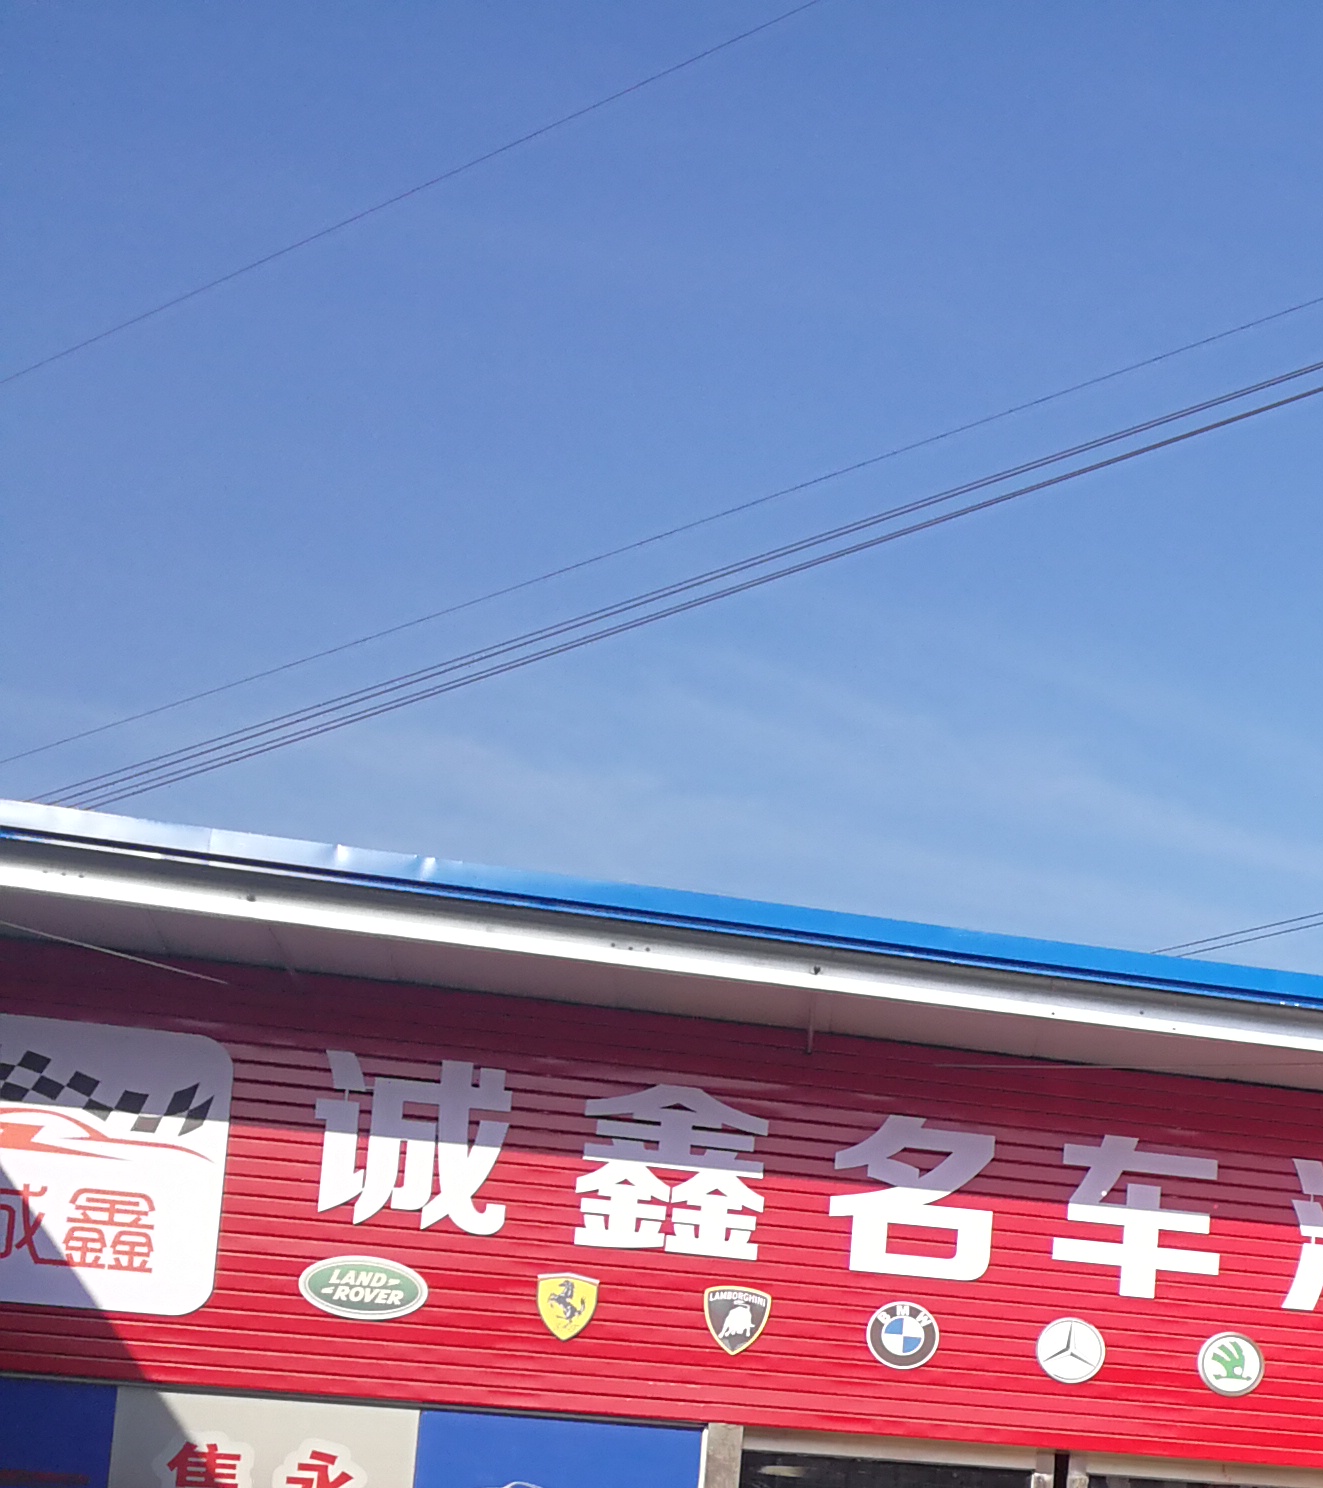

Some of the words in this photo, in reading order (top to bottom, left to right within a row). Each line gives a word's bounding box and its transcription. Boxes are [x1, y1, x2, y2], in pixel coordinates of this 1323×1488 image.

[329, 1269, 387, 1287] LAND
[332, 1286, 404, 1305] ROVER
[709, 1291, 766, 1307] LAMBORGHINI
[877, 1305, 932, 1328] BMW
